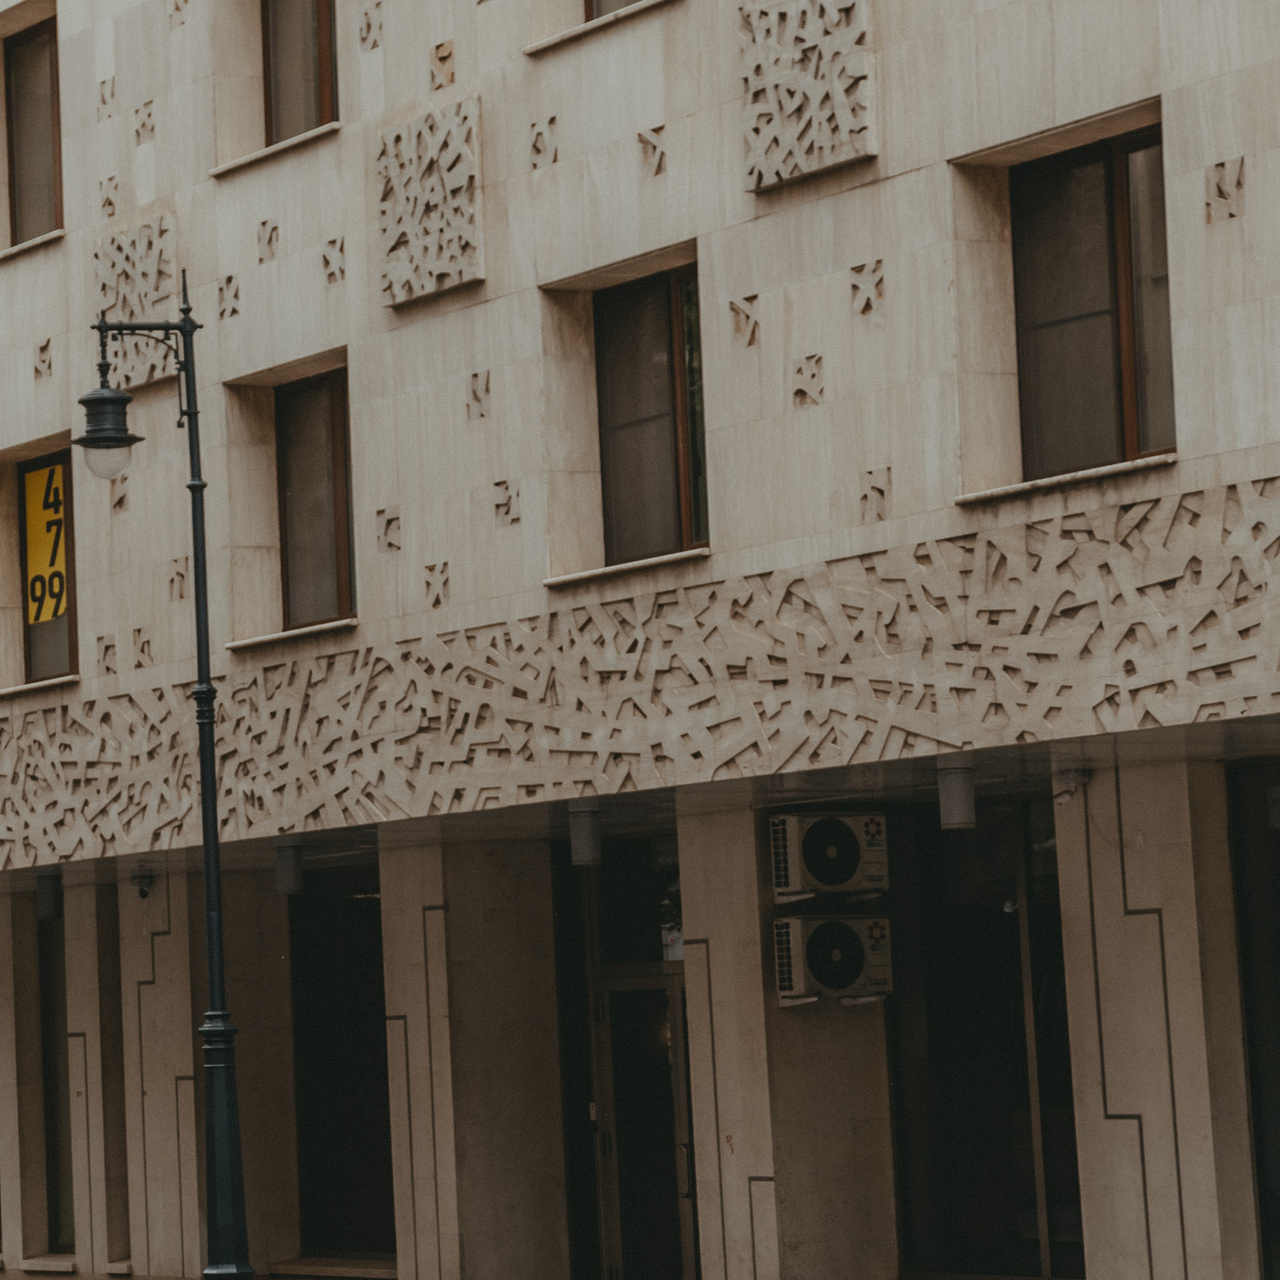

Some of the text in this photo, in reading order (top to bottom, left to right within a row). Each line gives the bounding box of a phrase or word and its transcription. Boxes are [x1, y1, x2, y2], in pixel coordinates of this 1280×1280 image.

[42, 466, 62, 515] 4
[46, 518, 63, 568] 7
[30, 570, 65, 622] 99
